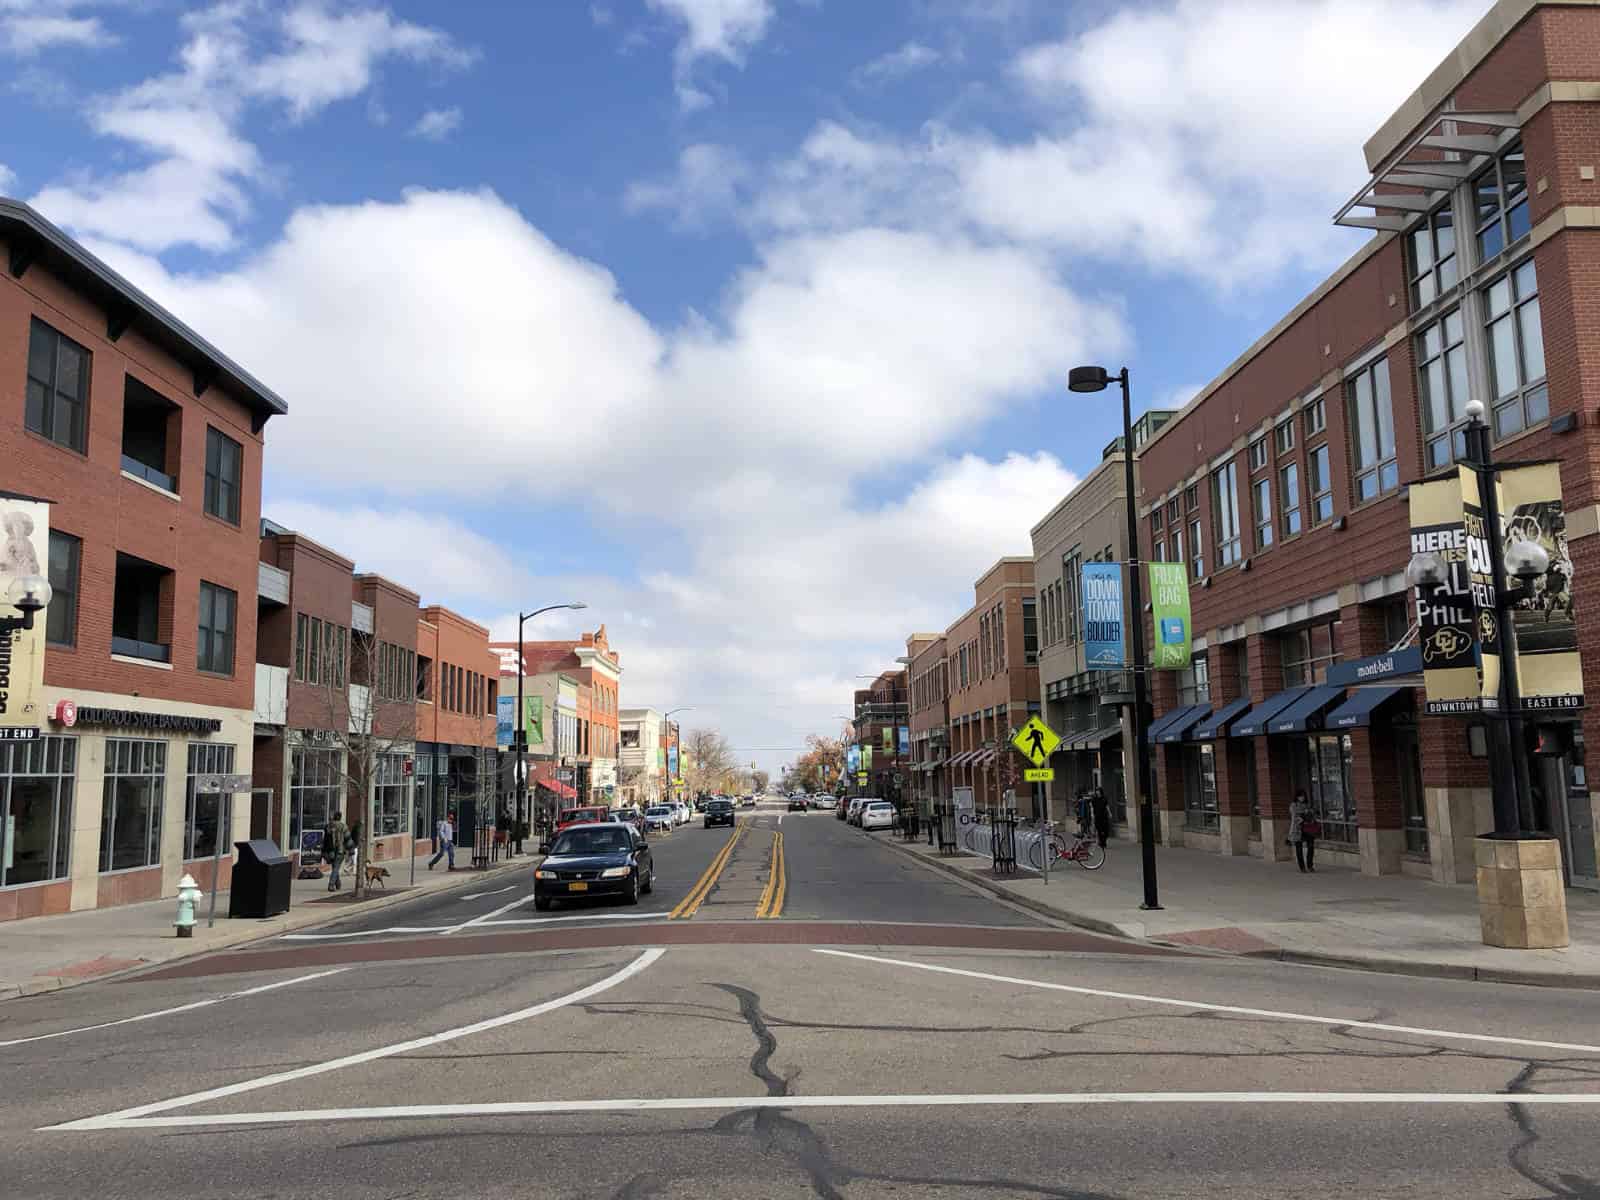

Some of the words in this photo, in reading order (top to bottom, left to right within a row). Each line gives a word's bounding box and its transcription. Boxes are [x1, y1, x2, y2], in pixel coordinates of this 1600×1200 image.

[1411, 528, 1466, 553] HERE
[1467, 536, 1491, 574] CU
[1087, 579, 1119, 600] DOWN
[1159, 586, 1182, 606] BAG
[1088, 600, 1120, 621] TOWN
[1087, 622, 1120, 641] BOULDER
[1430, 701, 1479, 712] DOWNTOWN
[1527, 698, 1552, 708] EAST
[1557, 696, 1578, 706] END
[14, 728, 33, 738] END
